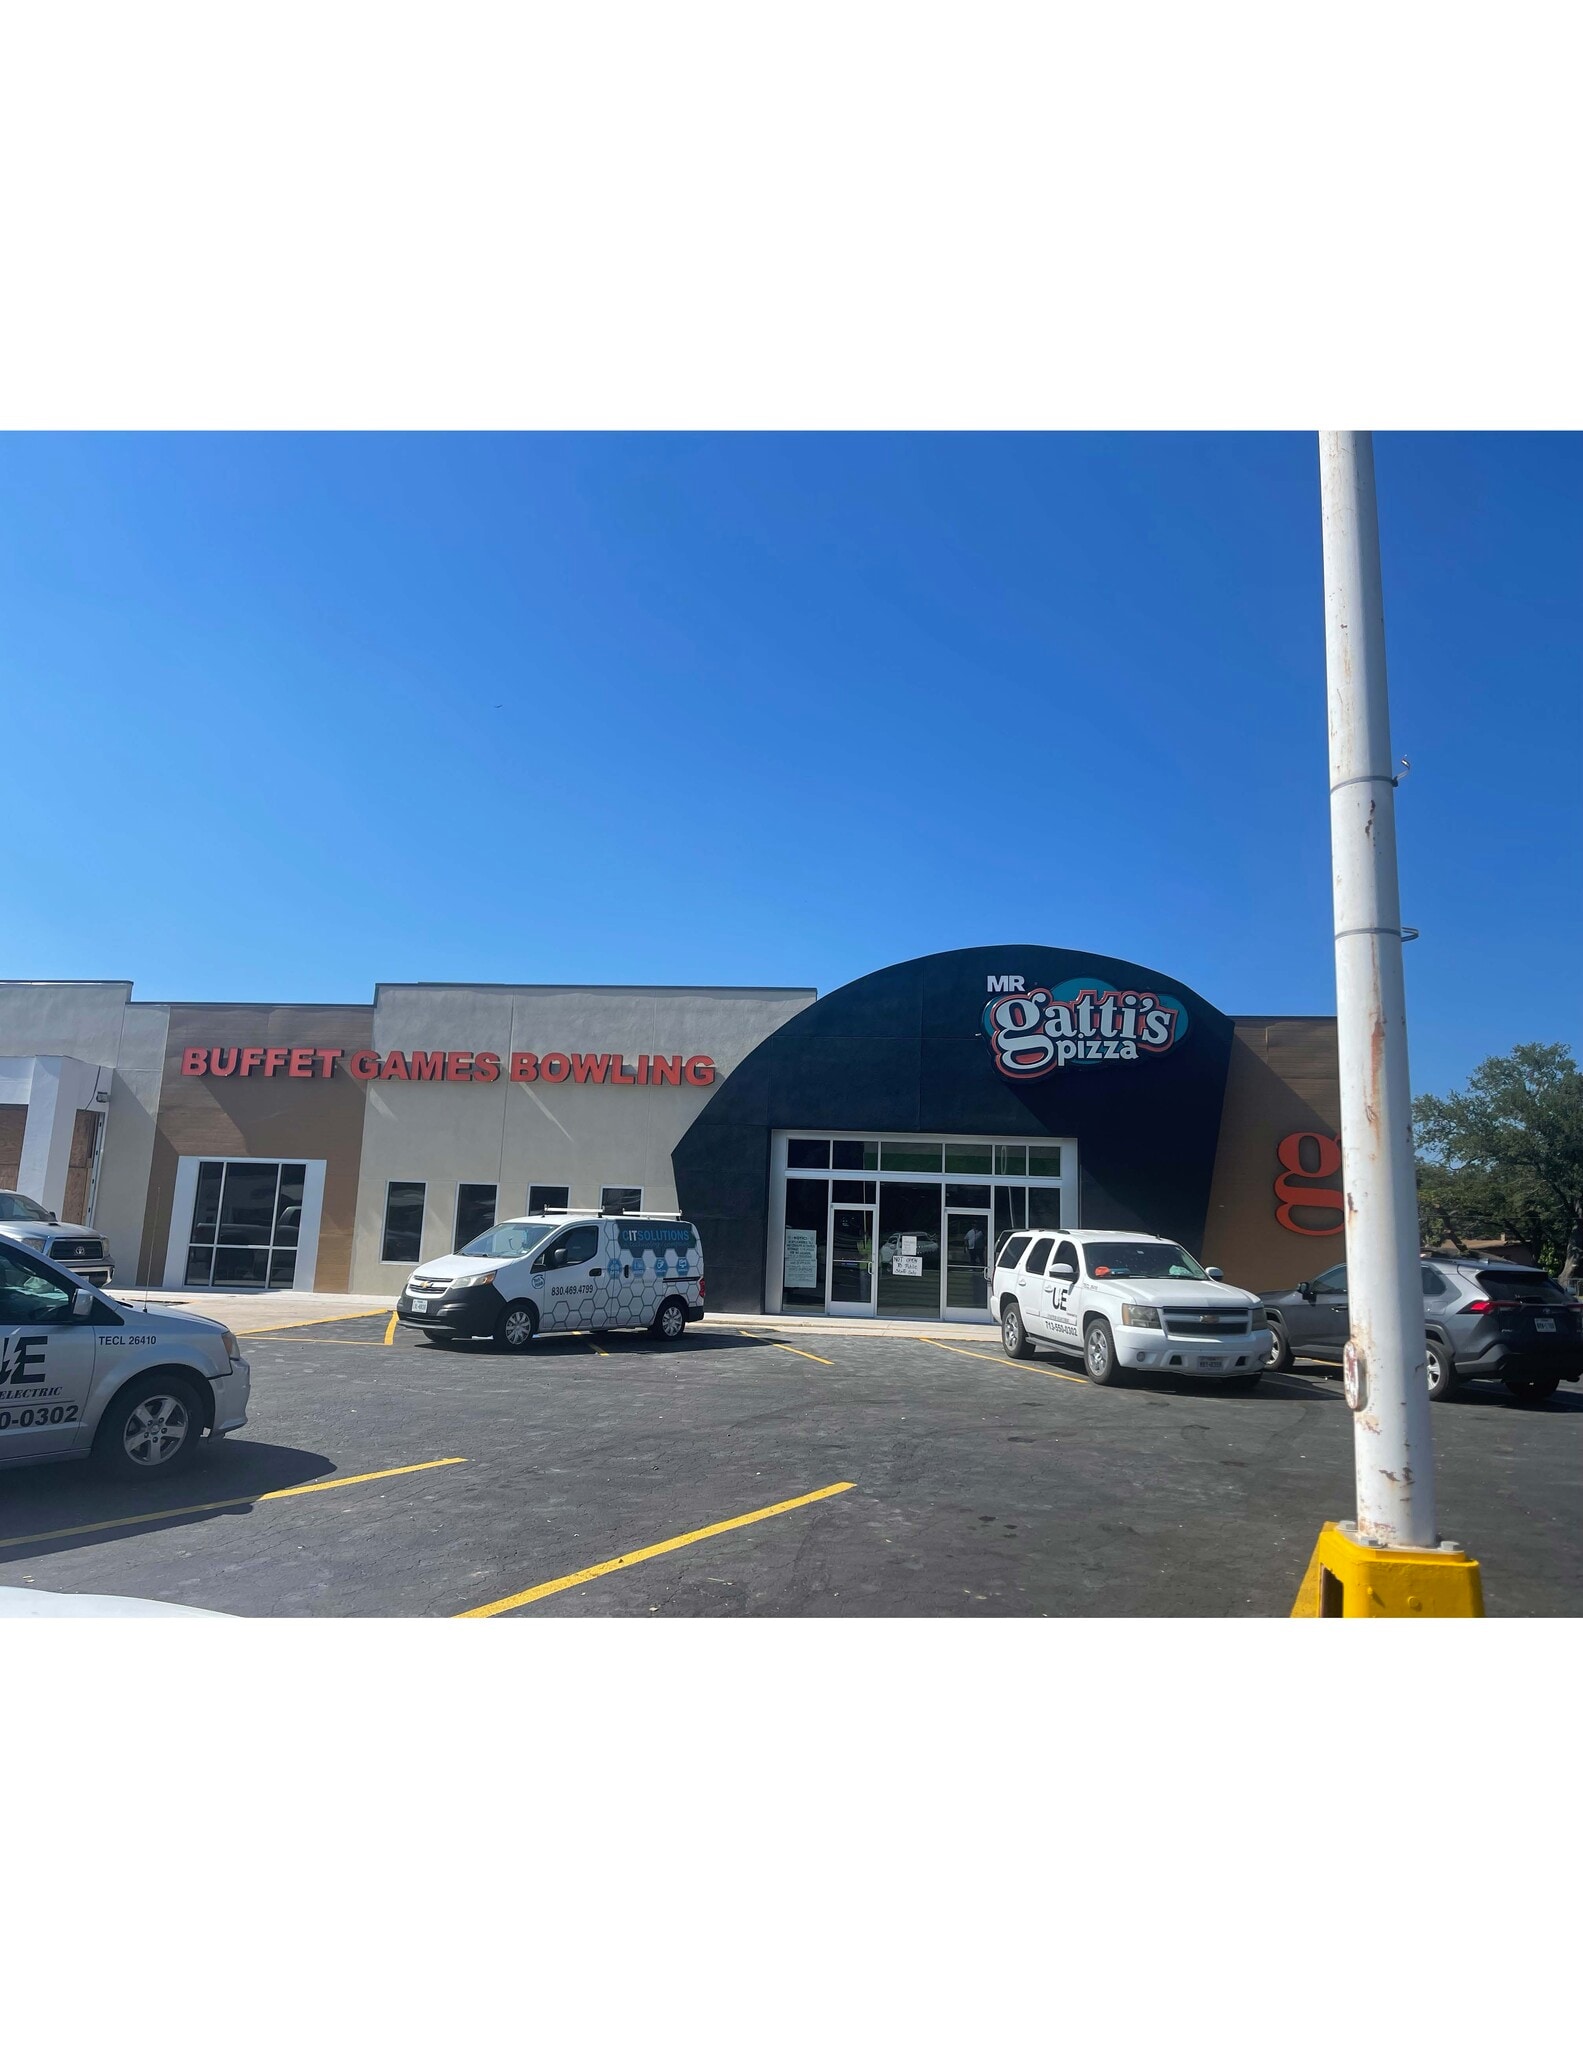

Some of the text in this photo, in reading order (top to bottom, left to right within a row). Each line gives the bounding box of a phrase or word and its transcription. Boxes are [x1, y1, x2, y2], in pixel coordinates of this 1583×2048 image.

[987, 975, 1026, 992] MR
[995, 992, 1171, 1070] gatti's
[1056, 1032, 1139, 1066] pizza
[181, 1047, 717, 1087] BUFFET GAMES BOWLING
[551, 1284, 594, 1297] 830.469.4799
[1045, 1320, 1078, 1337] 713-550-0302
[98, 1335, 157, 1346] TECL 26410
